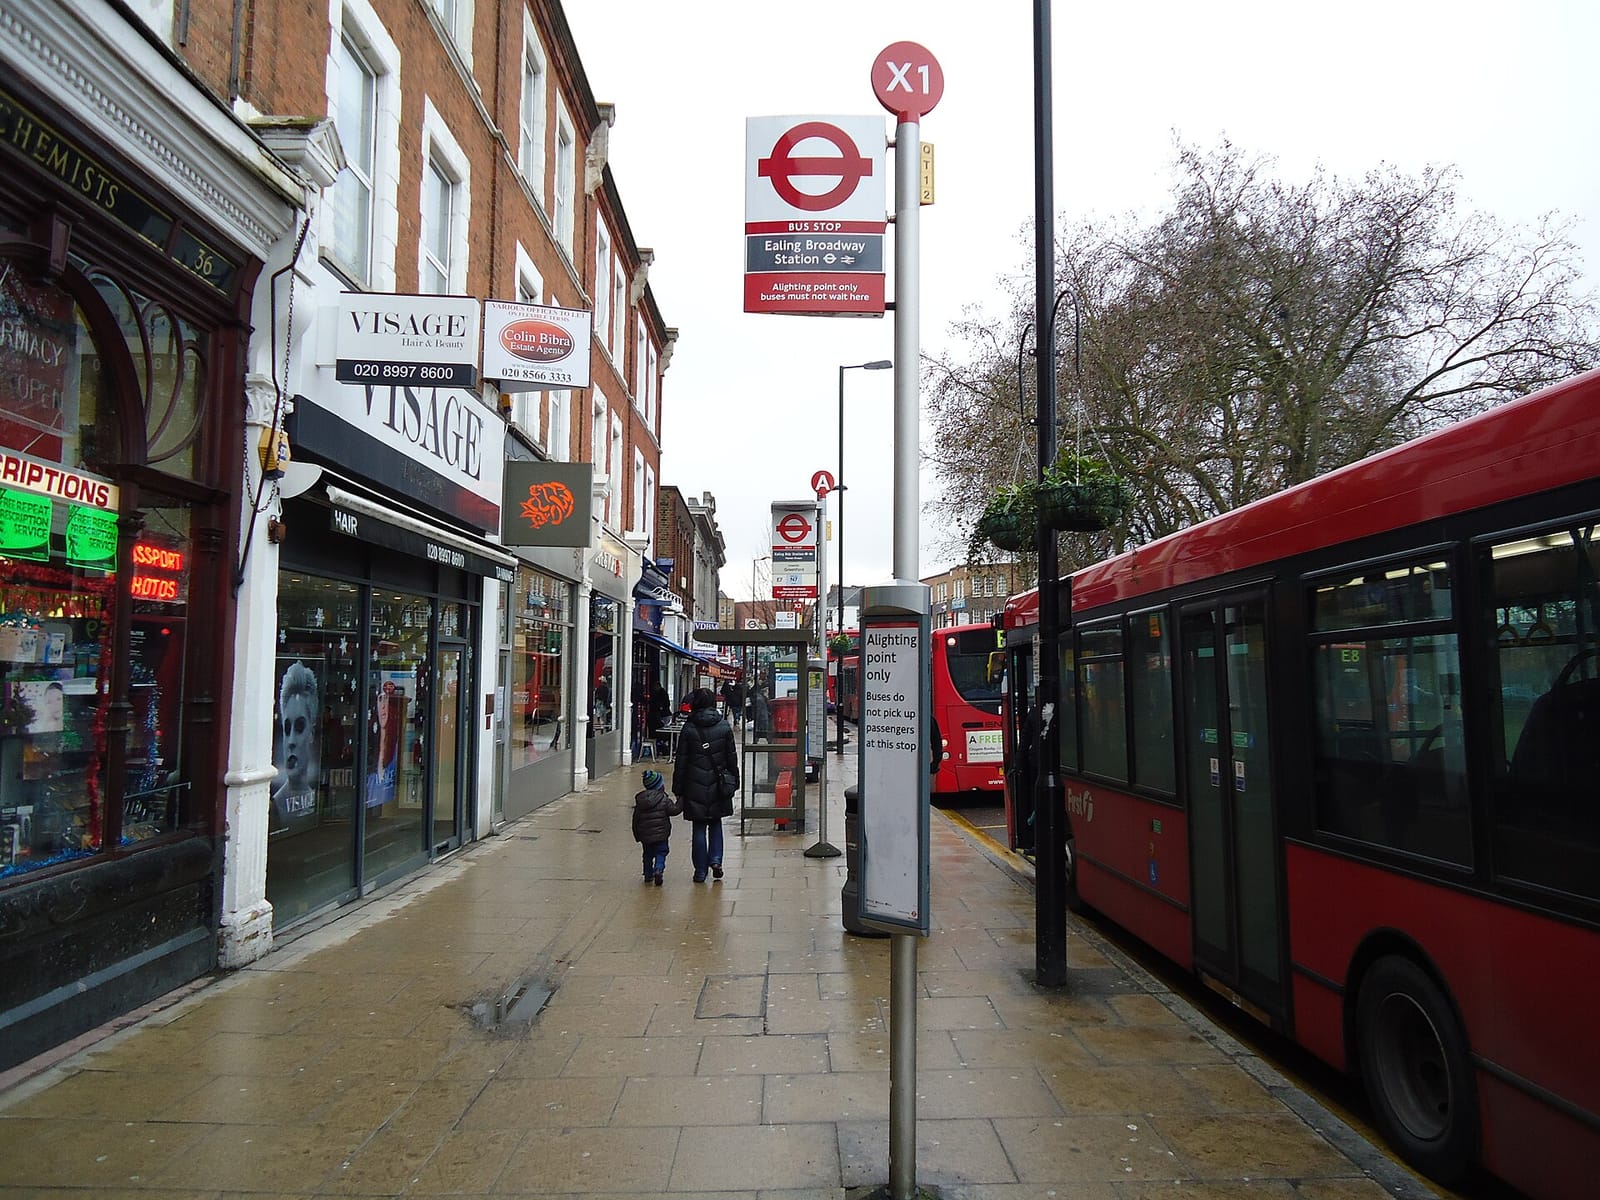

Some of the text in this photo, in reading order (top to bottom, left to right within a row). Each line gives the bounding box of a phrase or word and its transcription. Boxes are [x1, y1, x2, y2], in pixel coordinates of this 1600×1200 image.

[886, 62, 930, 94] X1
[788, 222, 841, 232] BUS STOP
[764, 239, 866, 253] Ealing Broadway
[194, 249, 213, 275] 36
[774, 253, 819, 265] Station
[772, 282, 858, 293] Alighting point only
[760, 293, 786, 301] buses
[829, 293, 848, 301] wait
[849, 293, 870, 301] here
[491, 303, 525, 312] VARIOUS
[350, 311, 466, 338] VISAGE
[402, 338, 465, 351] Hair & Beauty
[504, 329, 571, 347] Colin Bibra
[510, 341, 565, 355] Estate Agents
[354, 363, 454, 380] 020 8997 8600
[501, 367, 572, 383] 020 8566 3333
[364, 385, 483, 482] VISAGE
[0, 453, 110, 507] RIPTIONS
[815, 475, 831, 491] A
[334, 509, 358, 536] HAIR
[14, 523, 48, 539] SERVICE
[426, 543, 438, 560] 020
[866, 633, 918, 648] Alighting
[866, 651, 897, 666] point
[1341, 649, 1360, 662] E8
[866, 669, 891, 683] only
[866, 692, 905, 702] Buses do
[866, 708, 916, 720] not pick up
[866, 723, 915, 735] passengers
[866, 739, 917, 752] at this stop
[969, 735, 977, 744] A
